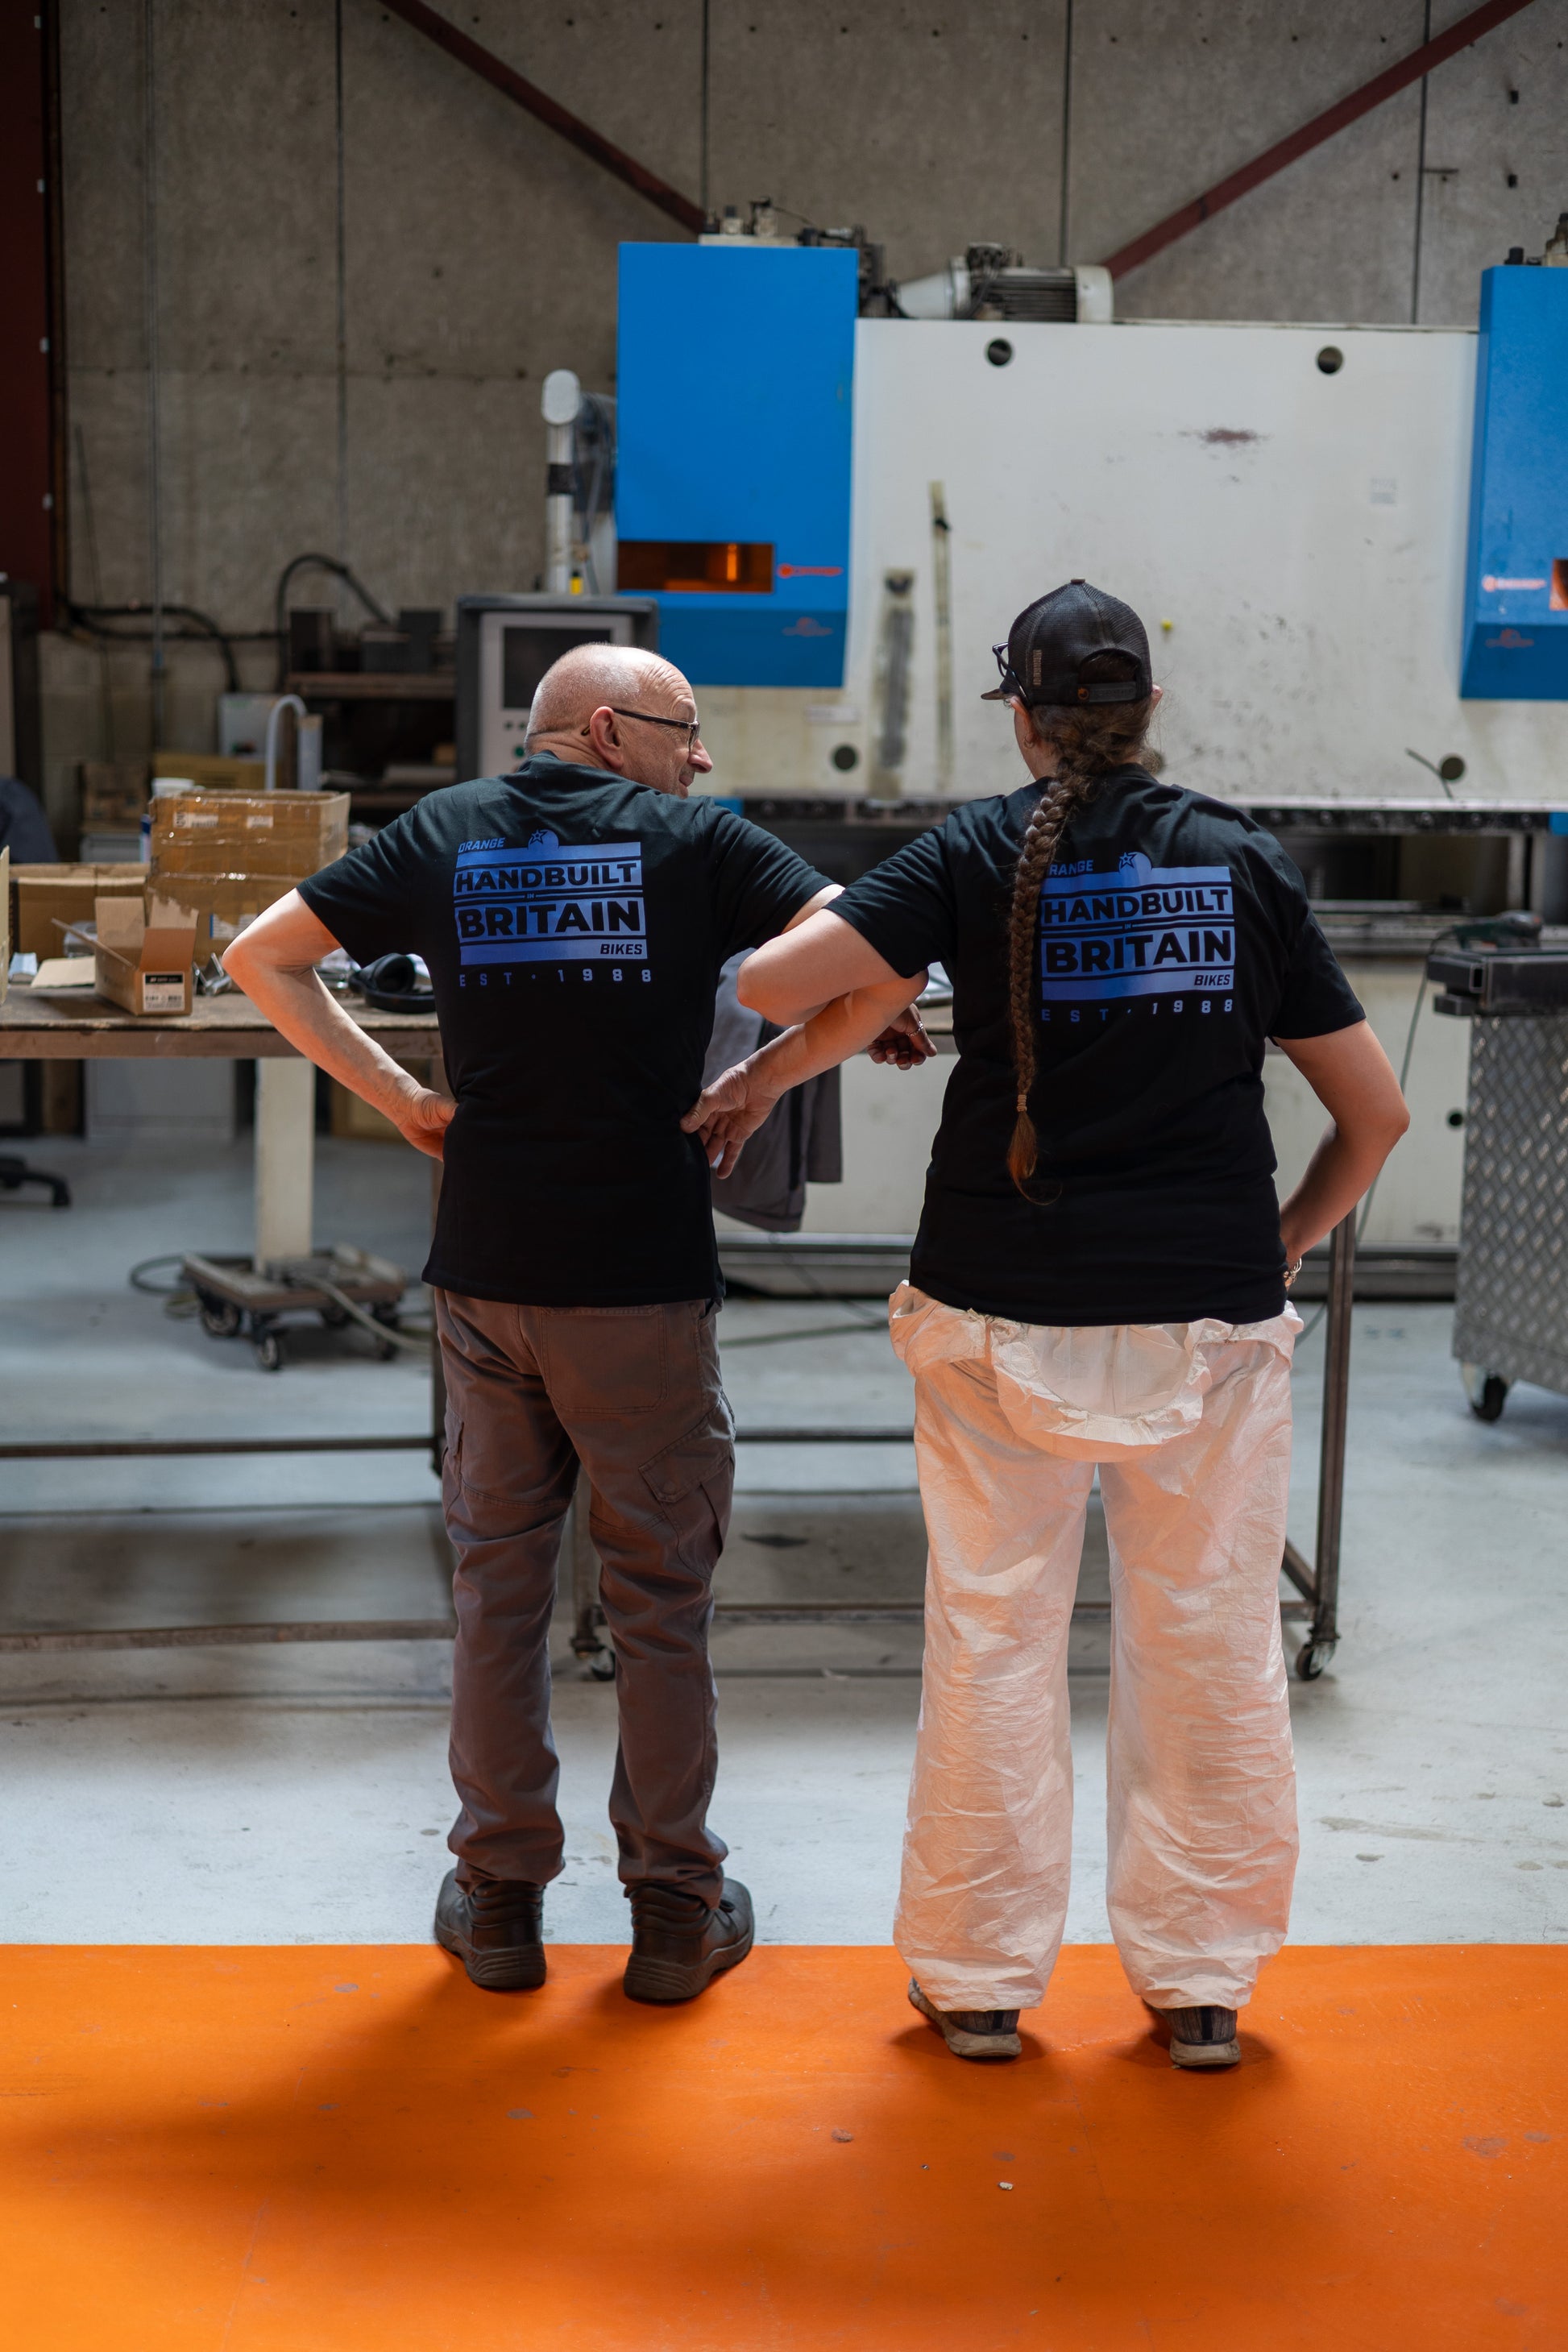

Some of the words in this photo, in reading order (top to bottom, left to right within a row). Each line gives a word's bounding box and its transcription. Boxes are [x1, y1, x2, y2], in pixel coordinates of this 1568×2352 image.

[458, 837, 506, 854] ORANGE
[454, 862, 637, 893] HANDBUILT
[1048, 860, 1094, 876] RANGE
[1043, 889, 1229, 924] HANDBUILT
[458, 900, 641, 939] BRITAIN
[599, 944, 643, 956] BIKES
[1045, 930, 1232, 973] BRITAIN
[1193, 974, 1231, 986] BIKES
